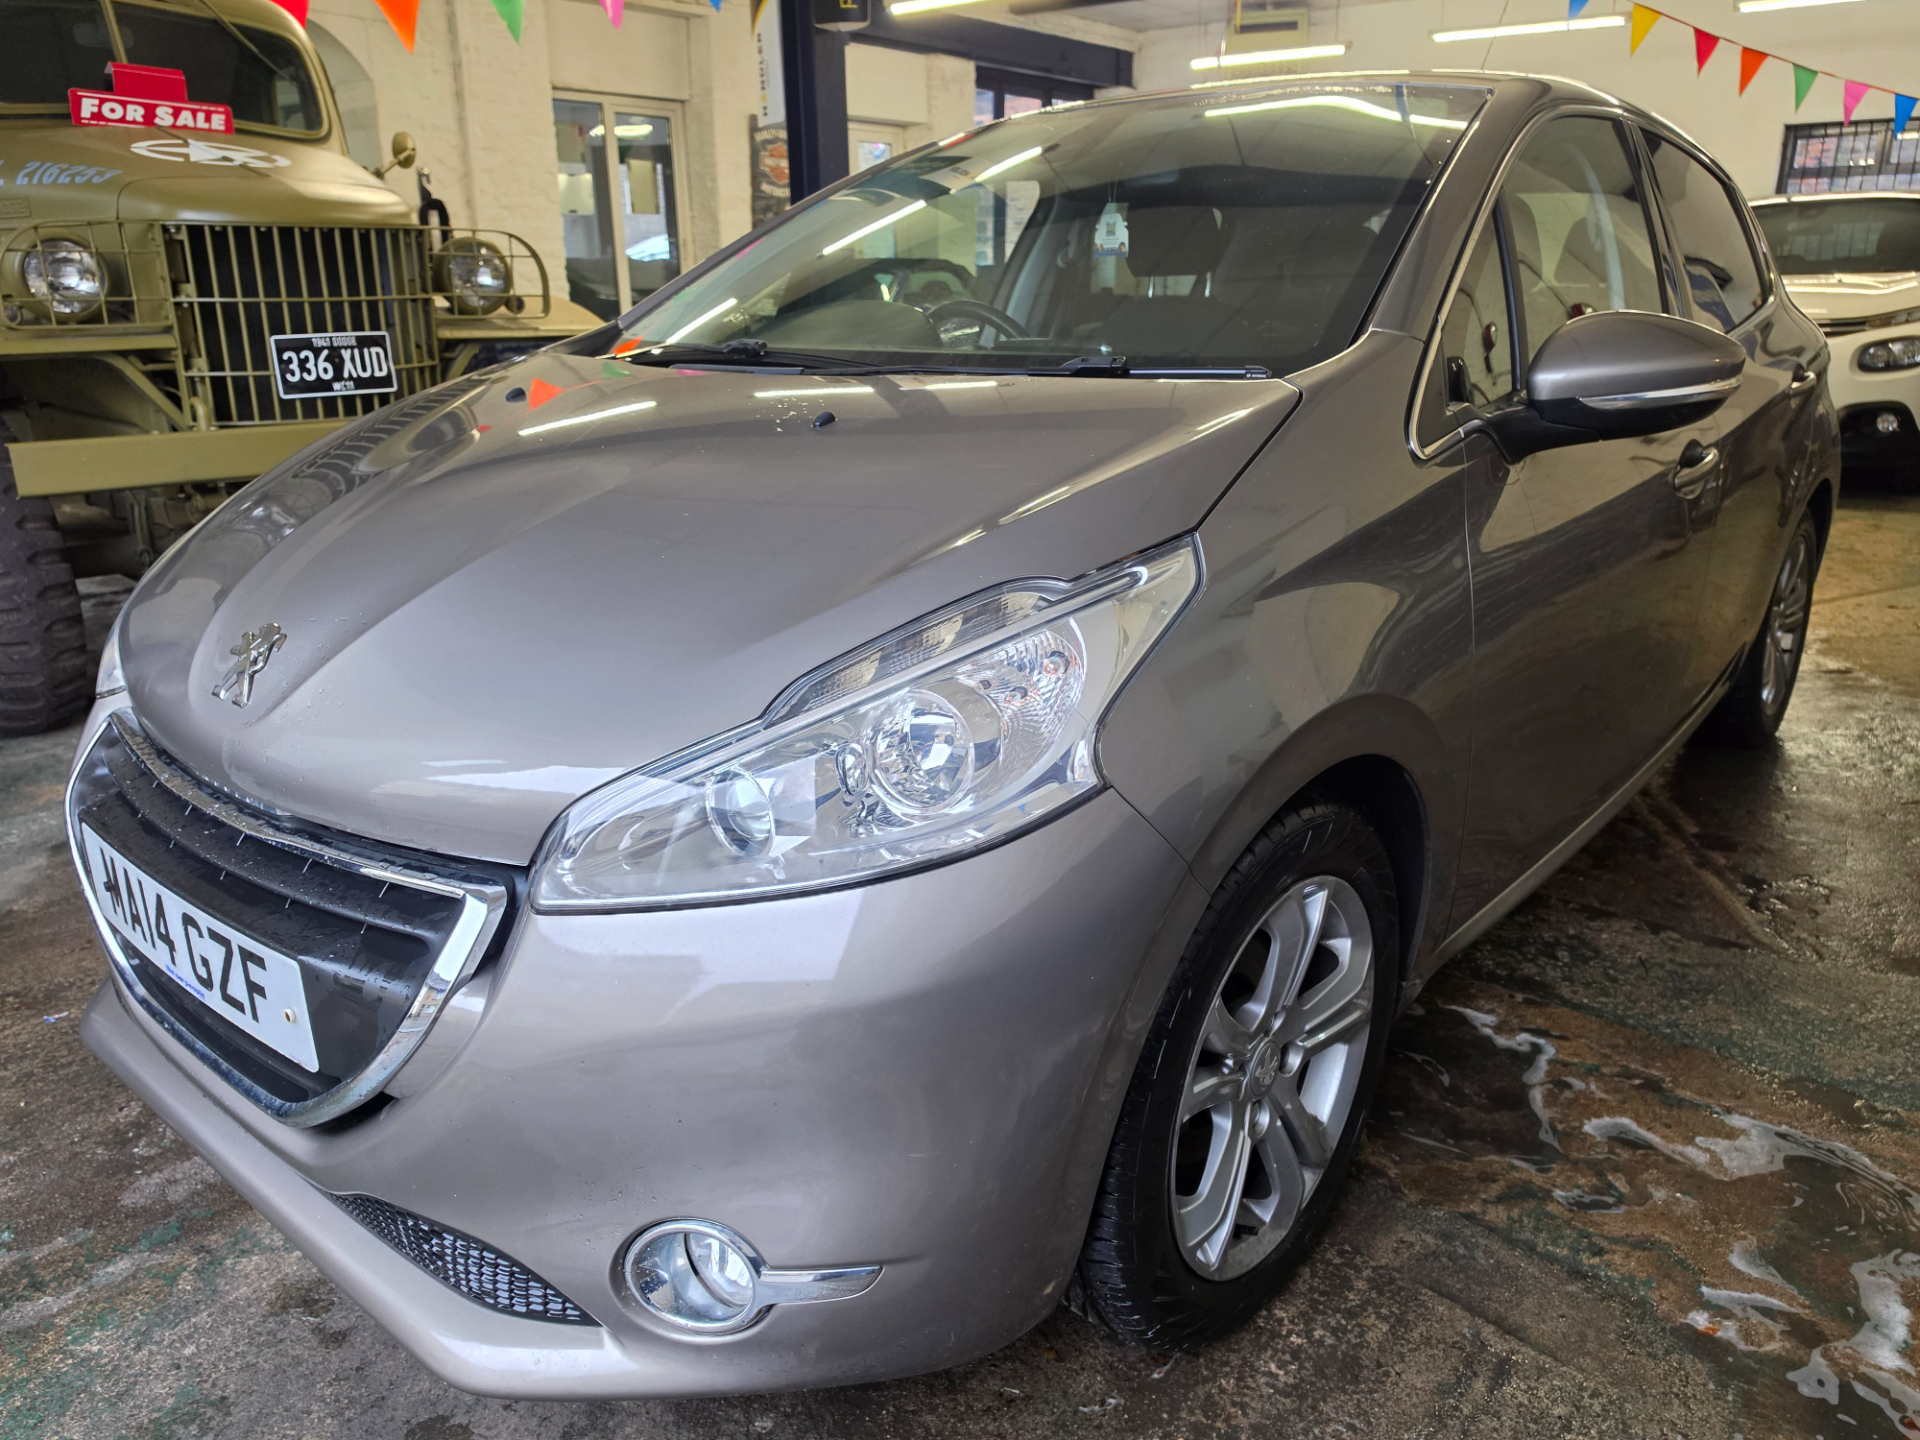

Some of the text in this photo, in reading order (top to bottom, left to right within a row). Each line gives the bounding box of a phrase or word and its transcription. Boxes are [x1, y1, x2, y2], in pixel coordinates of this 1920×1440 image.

[81, 98, 225, 130] FOR SALE
[332, 336, 357, 346] DODGE
[282, 346, 388, 382] 336 XUD
[99, 846, 268, 1024] MA14 GZF
